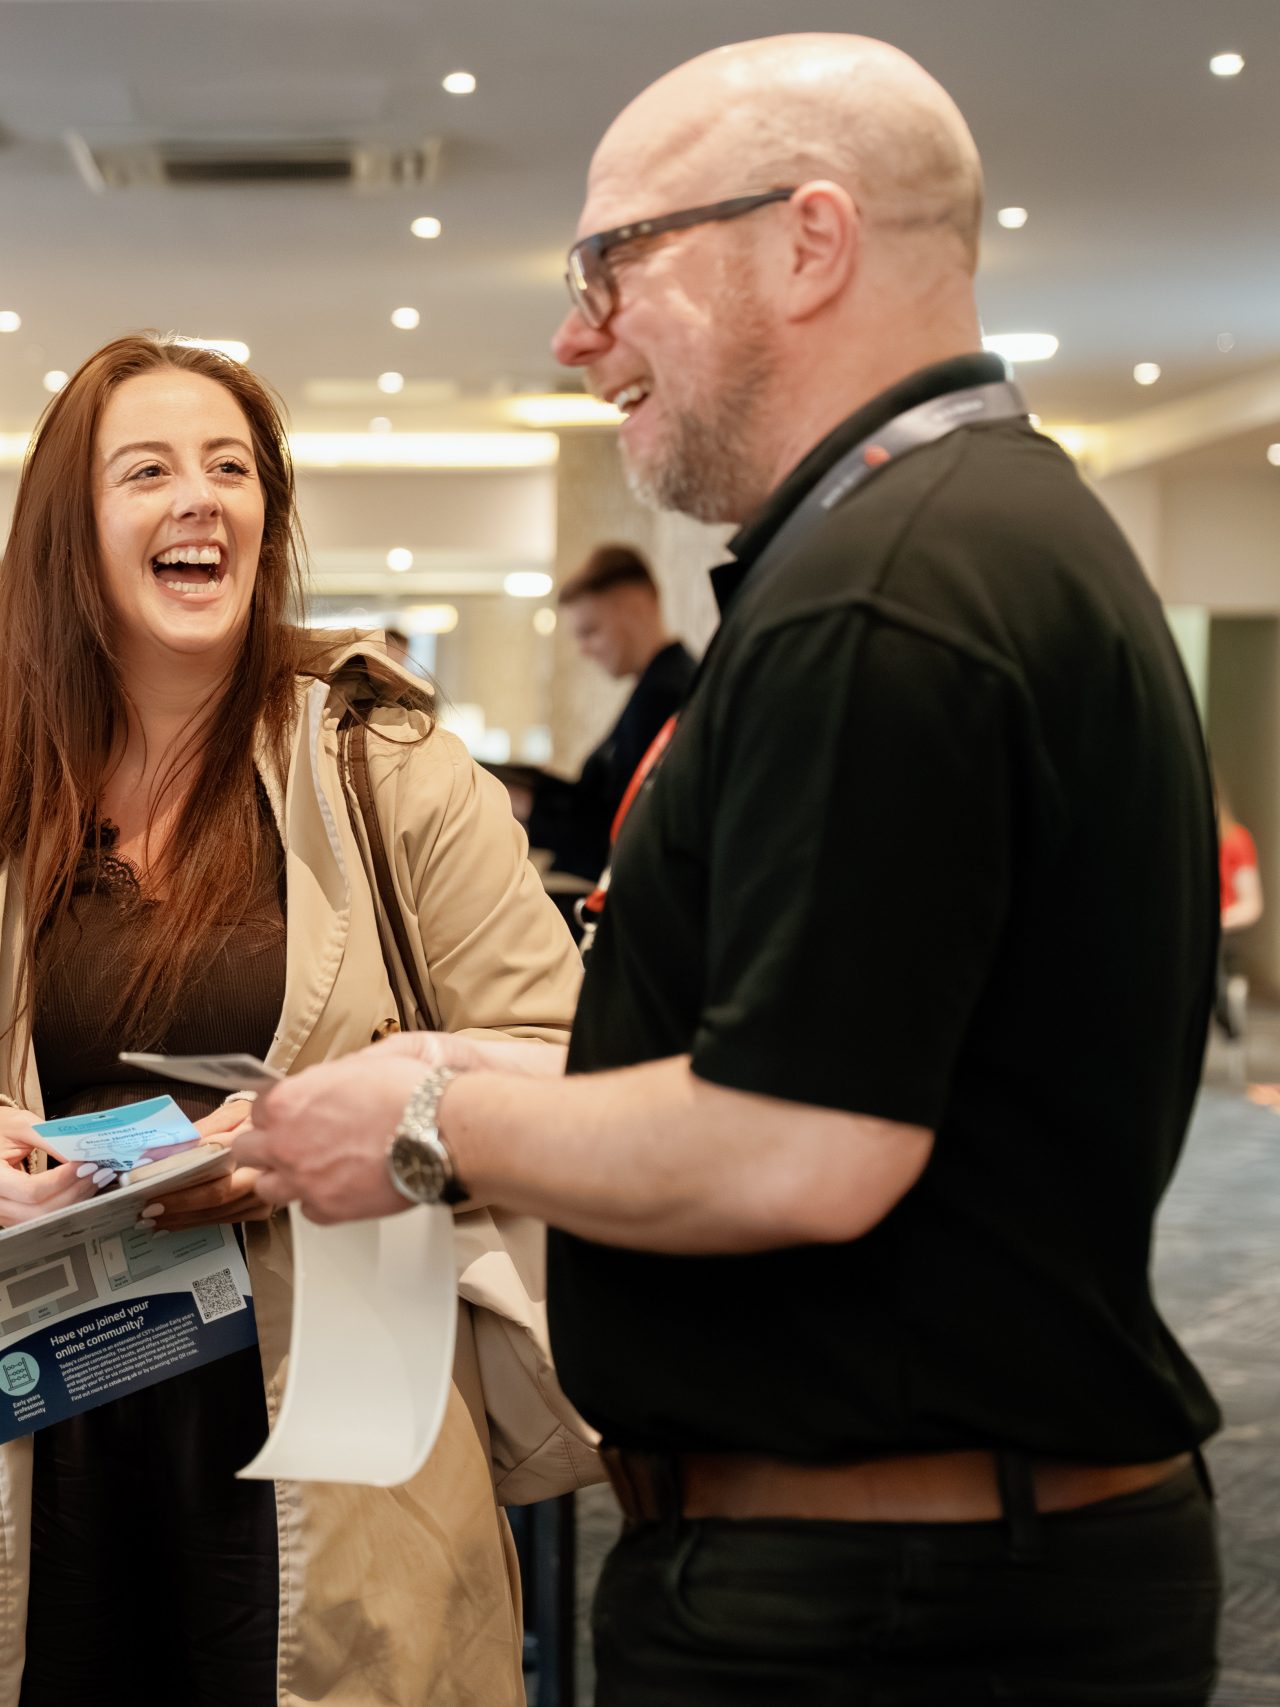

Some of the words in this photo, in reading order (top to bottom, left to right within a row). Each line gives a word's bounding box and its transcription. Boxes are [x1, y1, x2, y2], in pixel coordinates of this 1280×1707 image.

[50, 1331, 76, 1346] Have
[76, 1323, 95, 1337] you
[95, 1308, 126, 1330] joined
[126, 1300, 149, 1317] your
[55, 1342, 85, 1359] online
[86, 1315, 144, 1347] community?
[76, 1349, 102, 1363] conference
[113, 1335, 136, 1348] extension
[168, 1318, 181, 1326] Early
[181, 1312, 195, 1321] years
[61, 1360, 90, 1376] professional
[125, 1336, 152, 1350] community
[151, 1328, 173, 1340] connects
[172, 1324, 182, 1332] you
[181, 1320, 193, 1328] with
[63, 1369, 88, 1382] colleagues
[87, 1364, 100, 1372] from
[99, 1355, 121, 1367] different
[136, 1345, 146, 1353] and
[145, 1340, 160, 1349] offers
[159, 1333, 176, 1343] regular
[176, 1325, 198, 1337] webinars
[66, 1380, 76, 1388] and
[75, 1373, 94, 1384] support
[93, 1369, 104, 1377] that
[122, 1356, 138, 1366] access
[137, 1348, 156, 1359] anytime
[156, 1344, 166, 1352] and
[68, 1383, 87, 1394] through
[87, 1379, 98, 1387] your
[118, 1365, 134, 1374] mobile
[153, 1352, 167, 1360] Apple
[167, 1347, 176, 1355] and
[70, 1393, 82, 1401] Find
[90, 1385, 103, 1394] more
[149, 1359, 171, 1371] scanning
[12, 1399, 26, 1408] Early
[26, 1393, 41, 1403] years
[14, 1399, 45, 1416] professional
[17, 1407, 46, 1422] community
